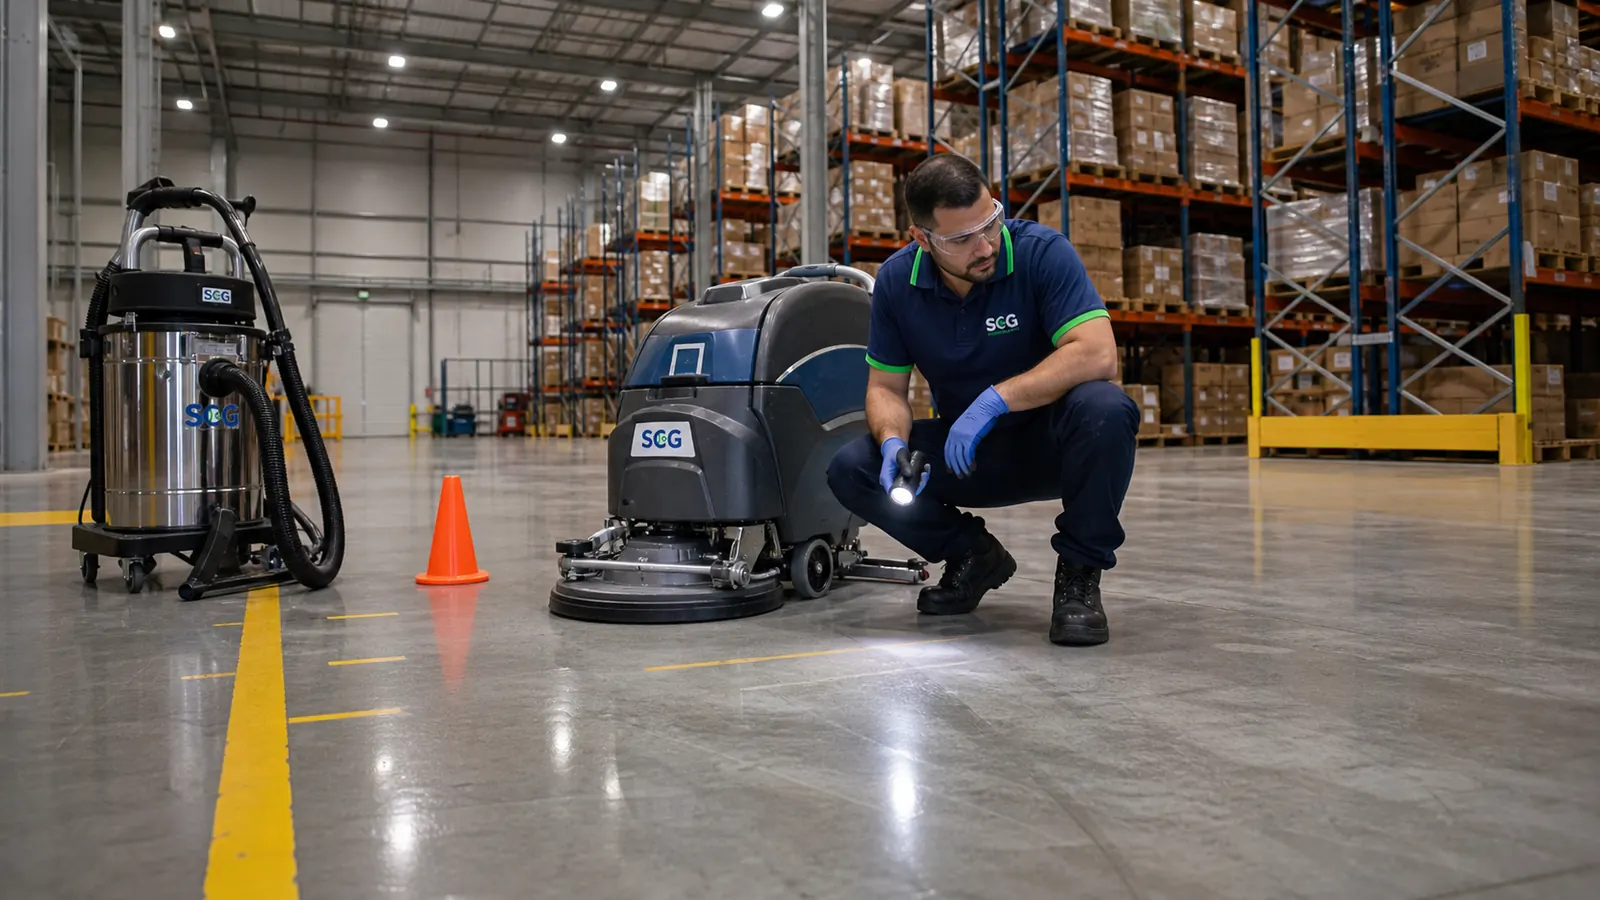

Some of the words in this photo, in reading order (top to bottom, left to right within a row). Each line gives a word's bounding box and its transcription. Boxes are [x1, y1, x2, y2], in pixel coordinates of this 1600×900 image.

[204, 290, 230, 301] SCG
[986, 314, 1019, 331] SCG
[185, 403, 239, 427] SCG
[641, 429, 682, 449] SCG
